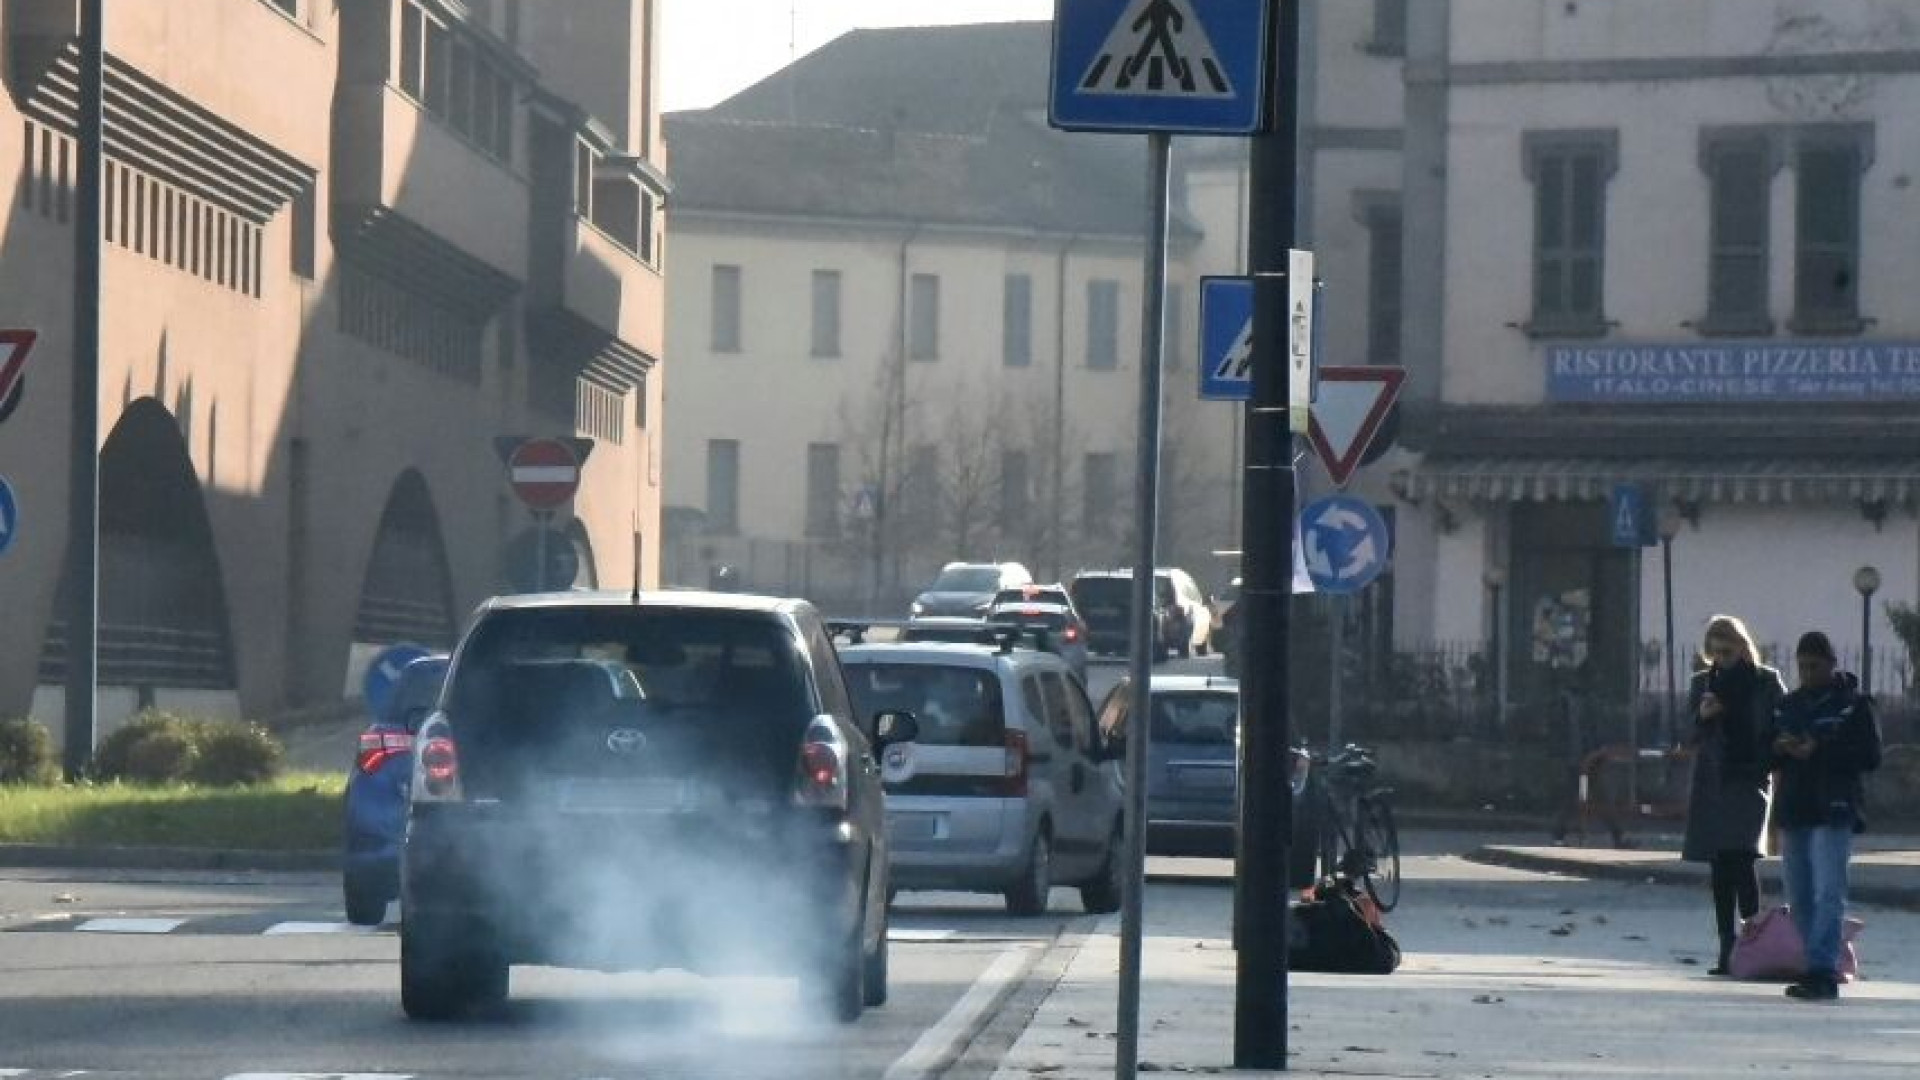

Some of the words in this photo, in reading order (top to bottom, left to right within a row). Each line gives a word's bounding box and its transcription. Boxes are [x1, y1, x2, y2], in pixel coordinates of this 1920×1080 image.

[1553, 347, 1735, 375] RISTORANTE
[1743, 347, 1881, 375] PIZZERIA
[1593, 377, 1776, 394] ITALO-CINESE
